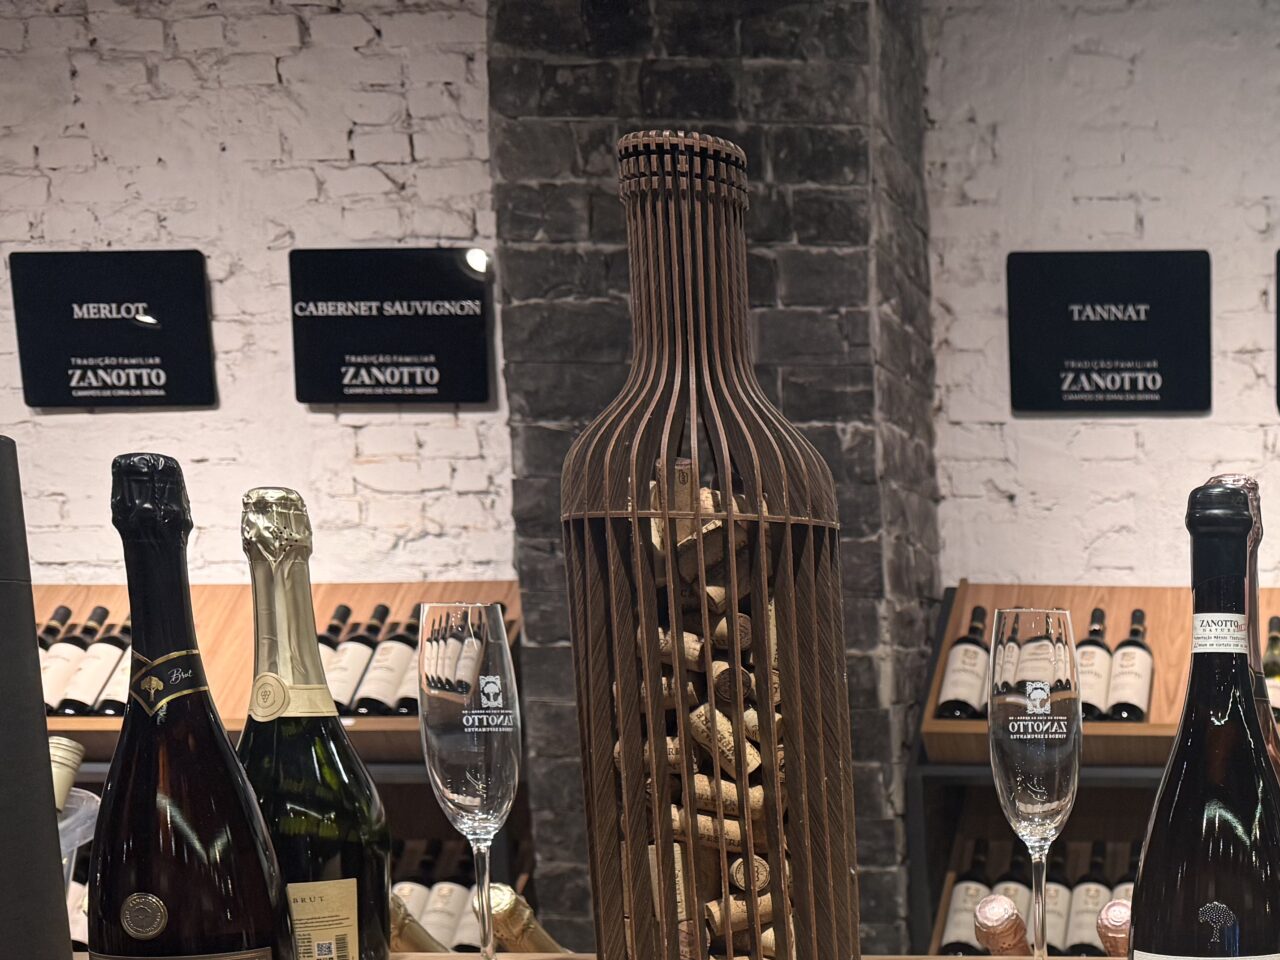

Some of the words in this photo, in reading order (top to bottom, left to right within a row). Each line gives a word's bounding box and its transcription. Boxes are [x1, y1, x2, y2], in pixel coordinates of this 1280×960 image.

[72, 303, 148, 319] MERLOT
[294, 301, 381, 317] CABERNET
[383, 300, 481, 317] SAUVIGNON
[1068, 304, 1150, 321] TANNAT
[68, 368, 167, 387] ZANOTTO
[340, 366, 440, 385] ZANOTTO
[1060, 371, 1163, 391] ZANOTTO
[1199, 619, 1239, 628] ZANOTTO
[168, 667, 192, 684] Brut
